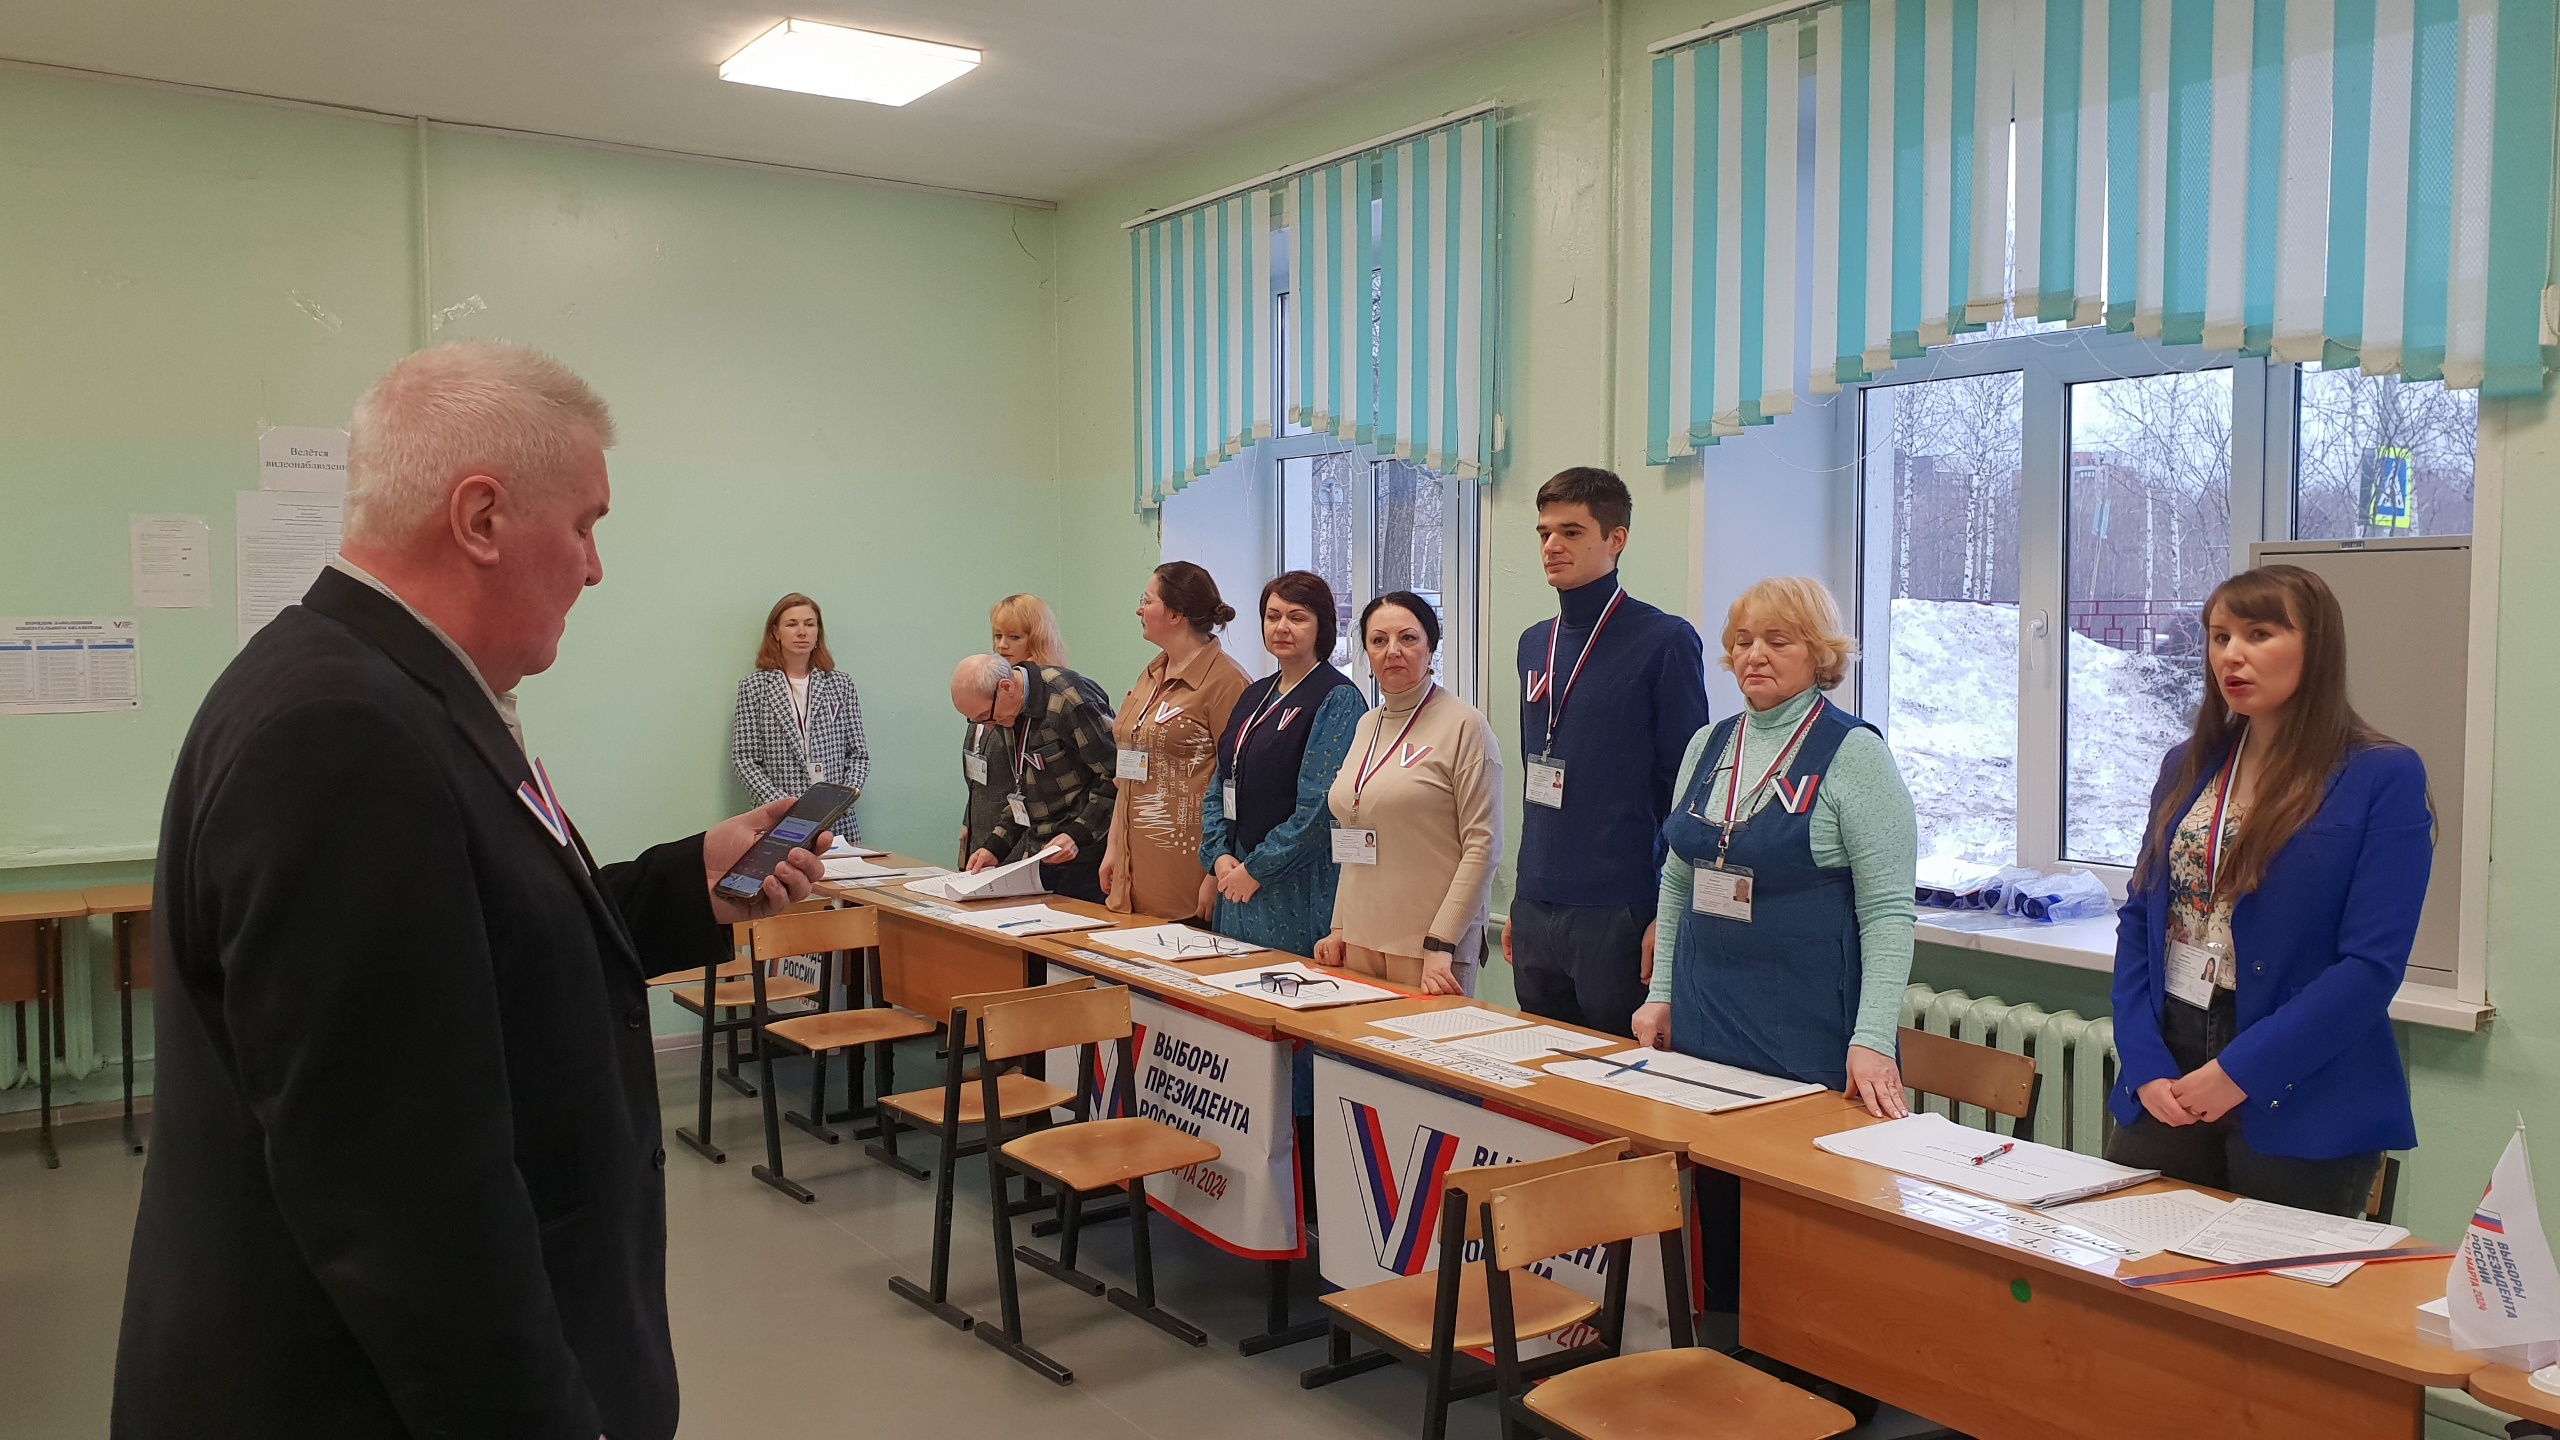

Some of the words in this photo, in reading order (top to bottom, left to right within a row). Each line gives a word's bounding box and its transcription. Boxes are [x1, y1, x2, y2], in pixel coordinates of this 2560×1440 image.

[290, 447, 329, 457] Ведётся
[783, 958, 815, 986] РОССИИ
[1153, 1032, 1230, 1083] ВЫБОРЫ
[1144, 1065, 1250, 1134] ПРЕЗИДЕНТА
[1197, 1167, 1227, 1200] 2024
[2465, 1256, 2480, 1287] МАРТА
[2471, 1233, 2493, 1285] РОССИИ
[2482, 1237, 2518, 1319] ПРЕЗИДЕНТА
[2497, 1241, 2527, 1299] ВЫБОРЫ
